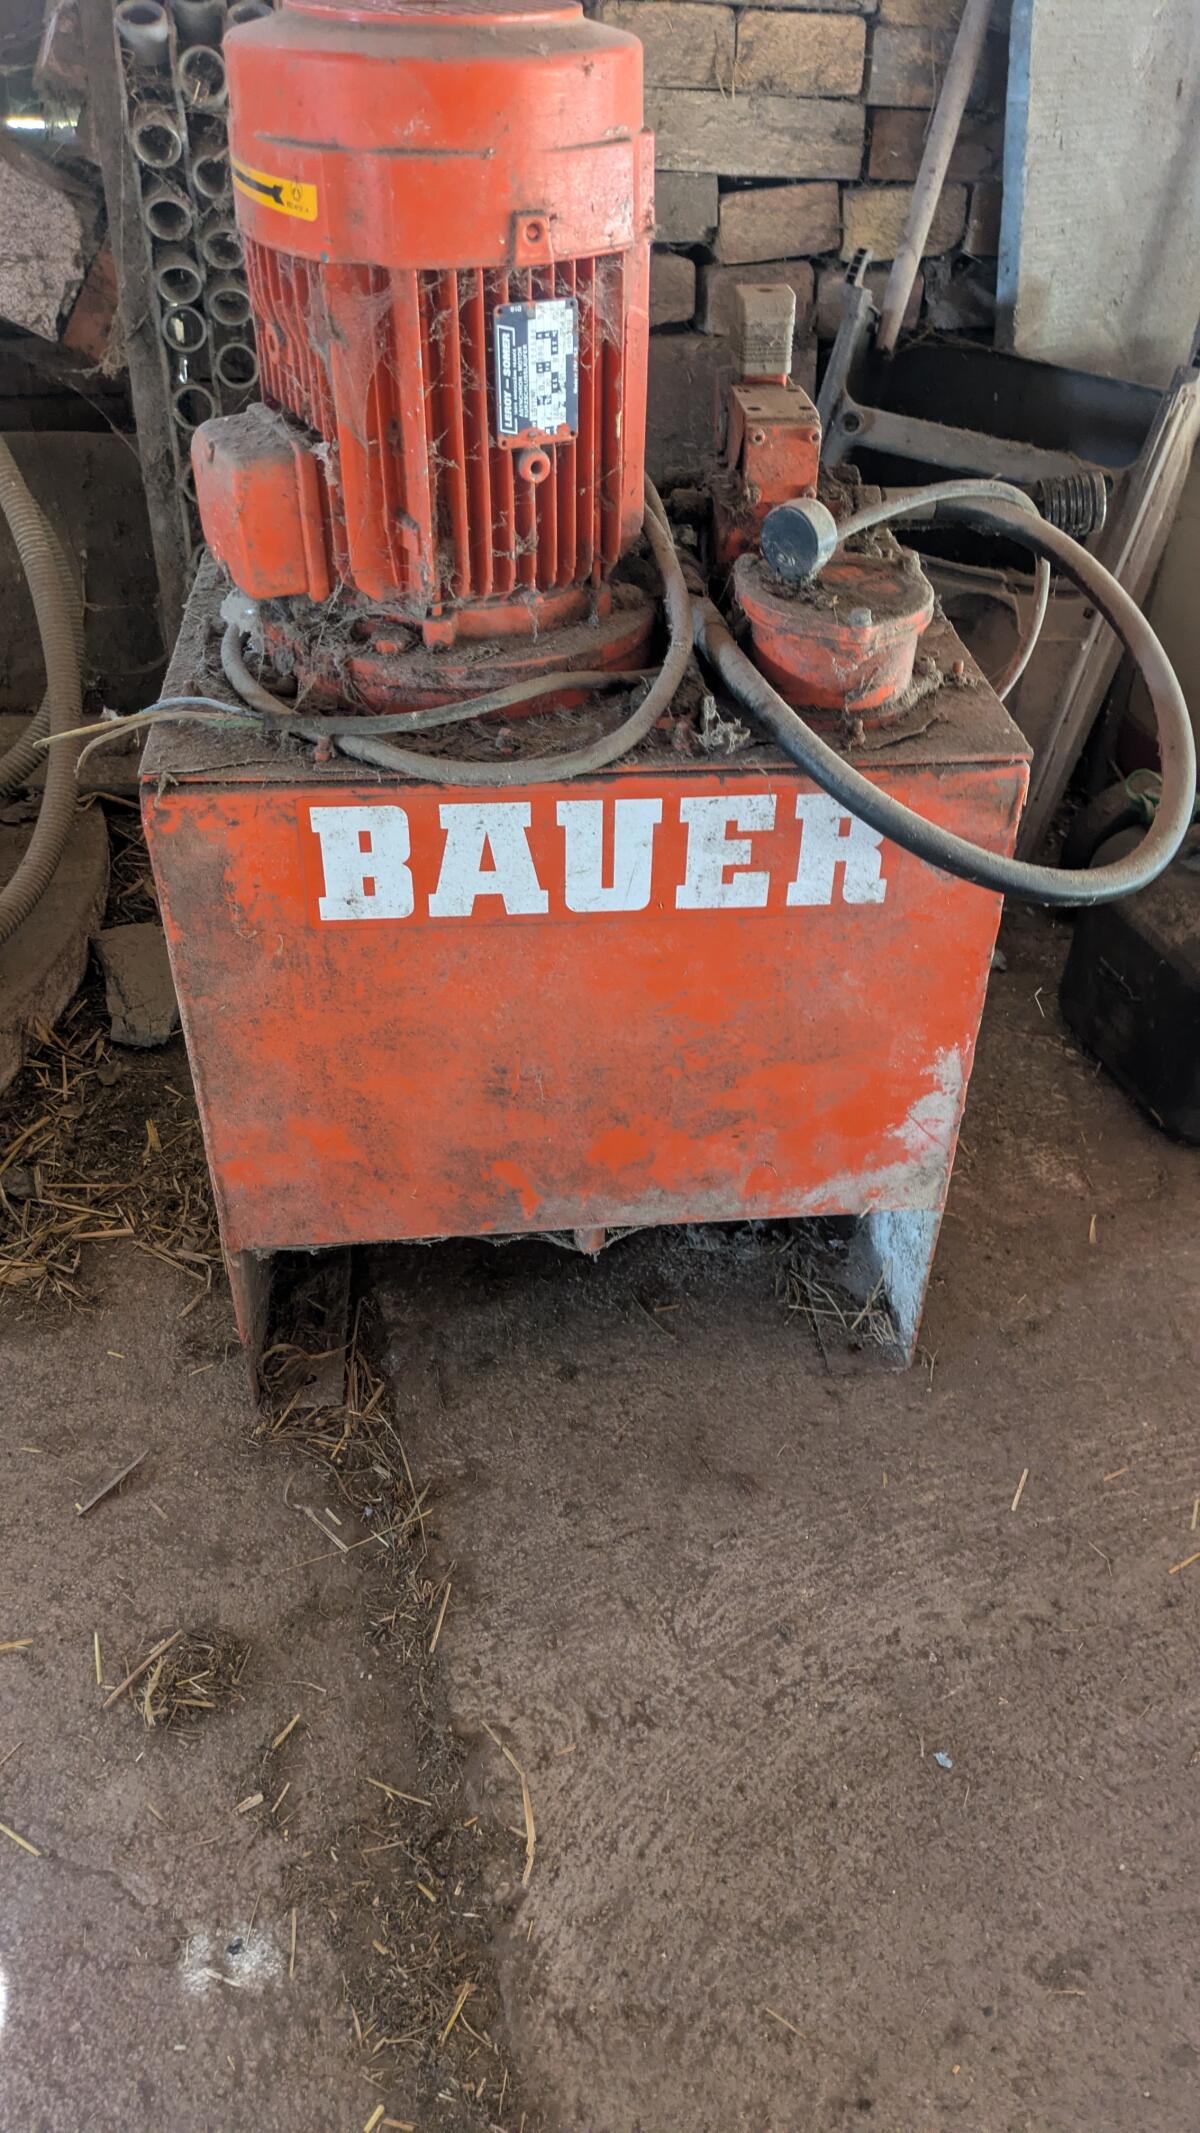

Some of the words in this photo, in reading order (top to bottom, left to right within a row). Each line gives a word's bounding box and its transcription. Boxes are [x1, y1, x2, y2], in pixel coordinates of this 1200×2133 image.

[502, 332, 511, 377] SOMER
[503, 391, 513, 428] LEROY
[309, 793, 887, 921] BAUER
